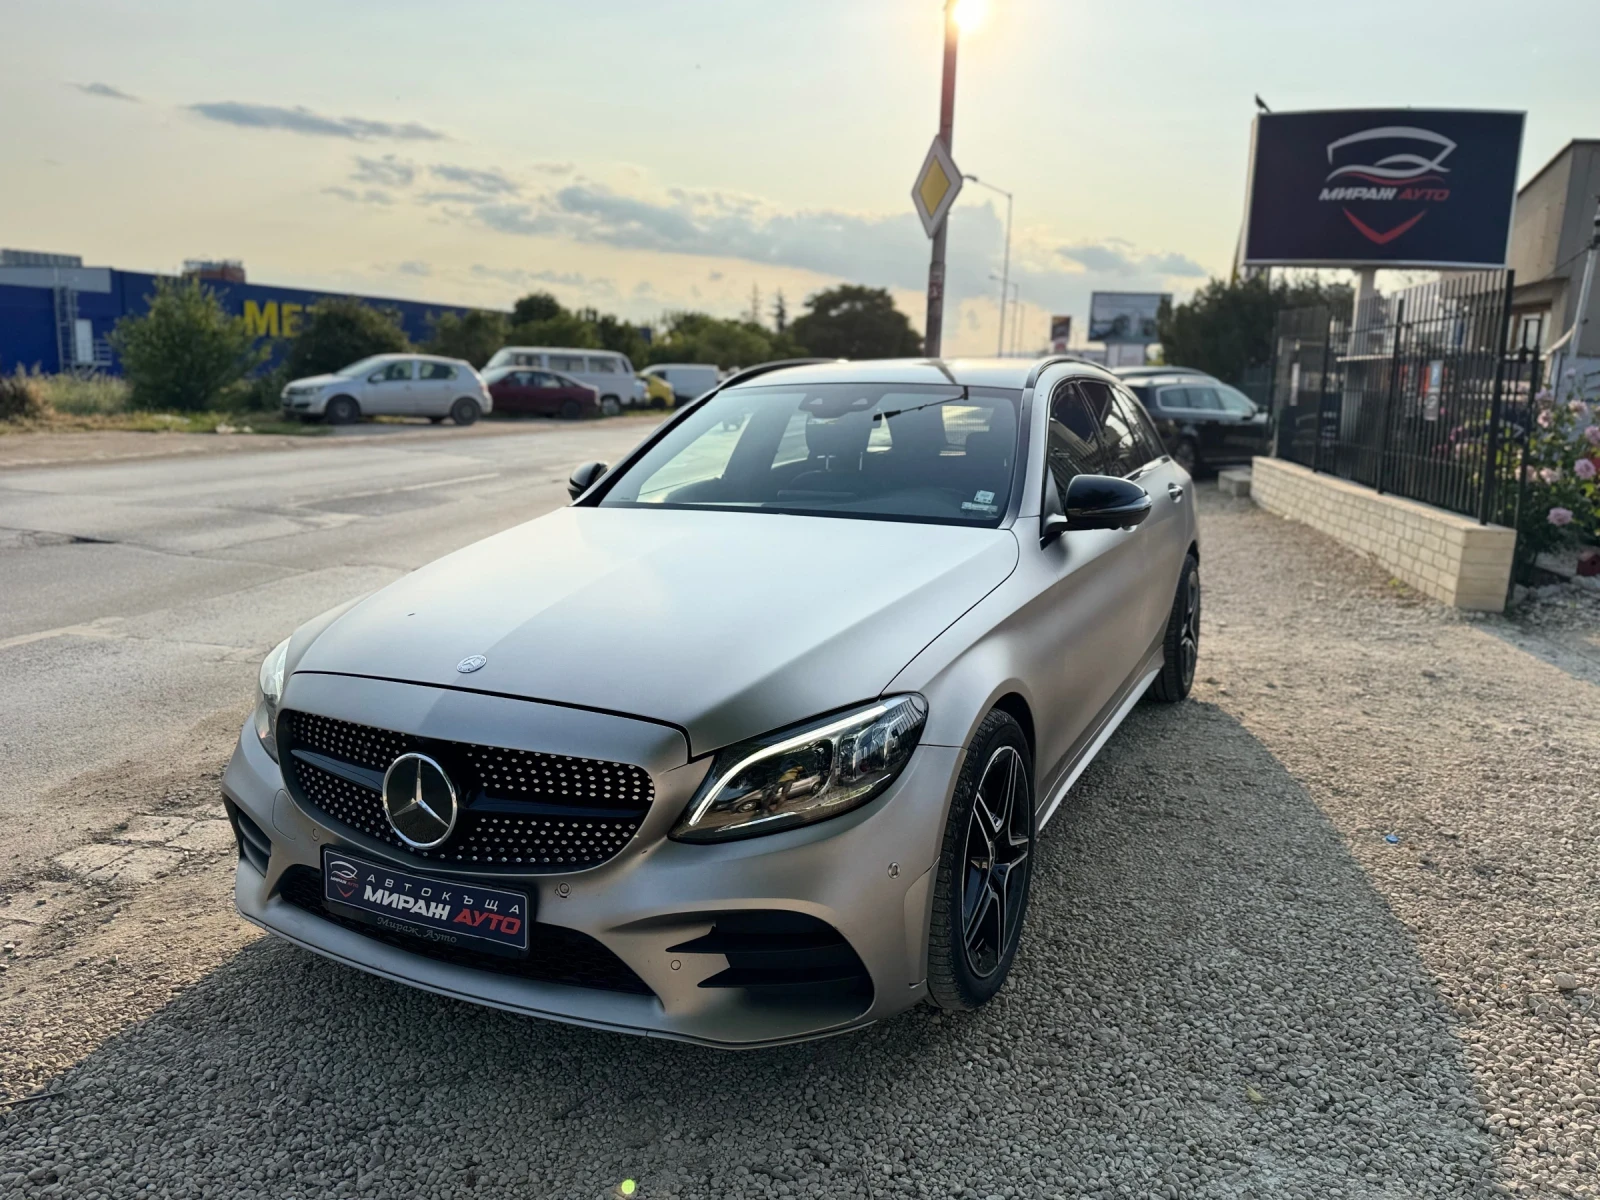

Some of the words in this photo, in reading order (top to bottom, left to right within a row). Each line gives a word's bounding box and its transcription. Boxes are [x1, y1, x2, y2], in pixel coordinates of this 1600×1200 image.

[1318, 187, 1398, 201] МИРАЖ
[1398, 188, 1451, 201] АУТО
[363, 885, 451, 921] МИРАЖ
[453, 908, 521, 935] АУТО
[377, 916, 421, 937] Мираж
[423, 929, 457, 944] Ауто
